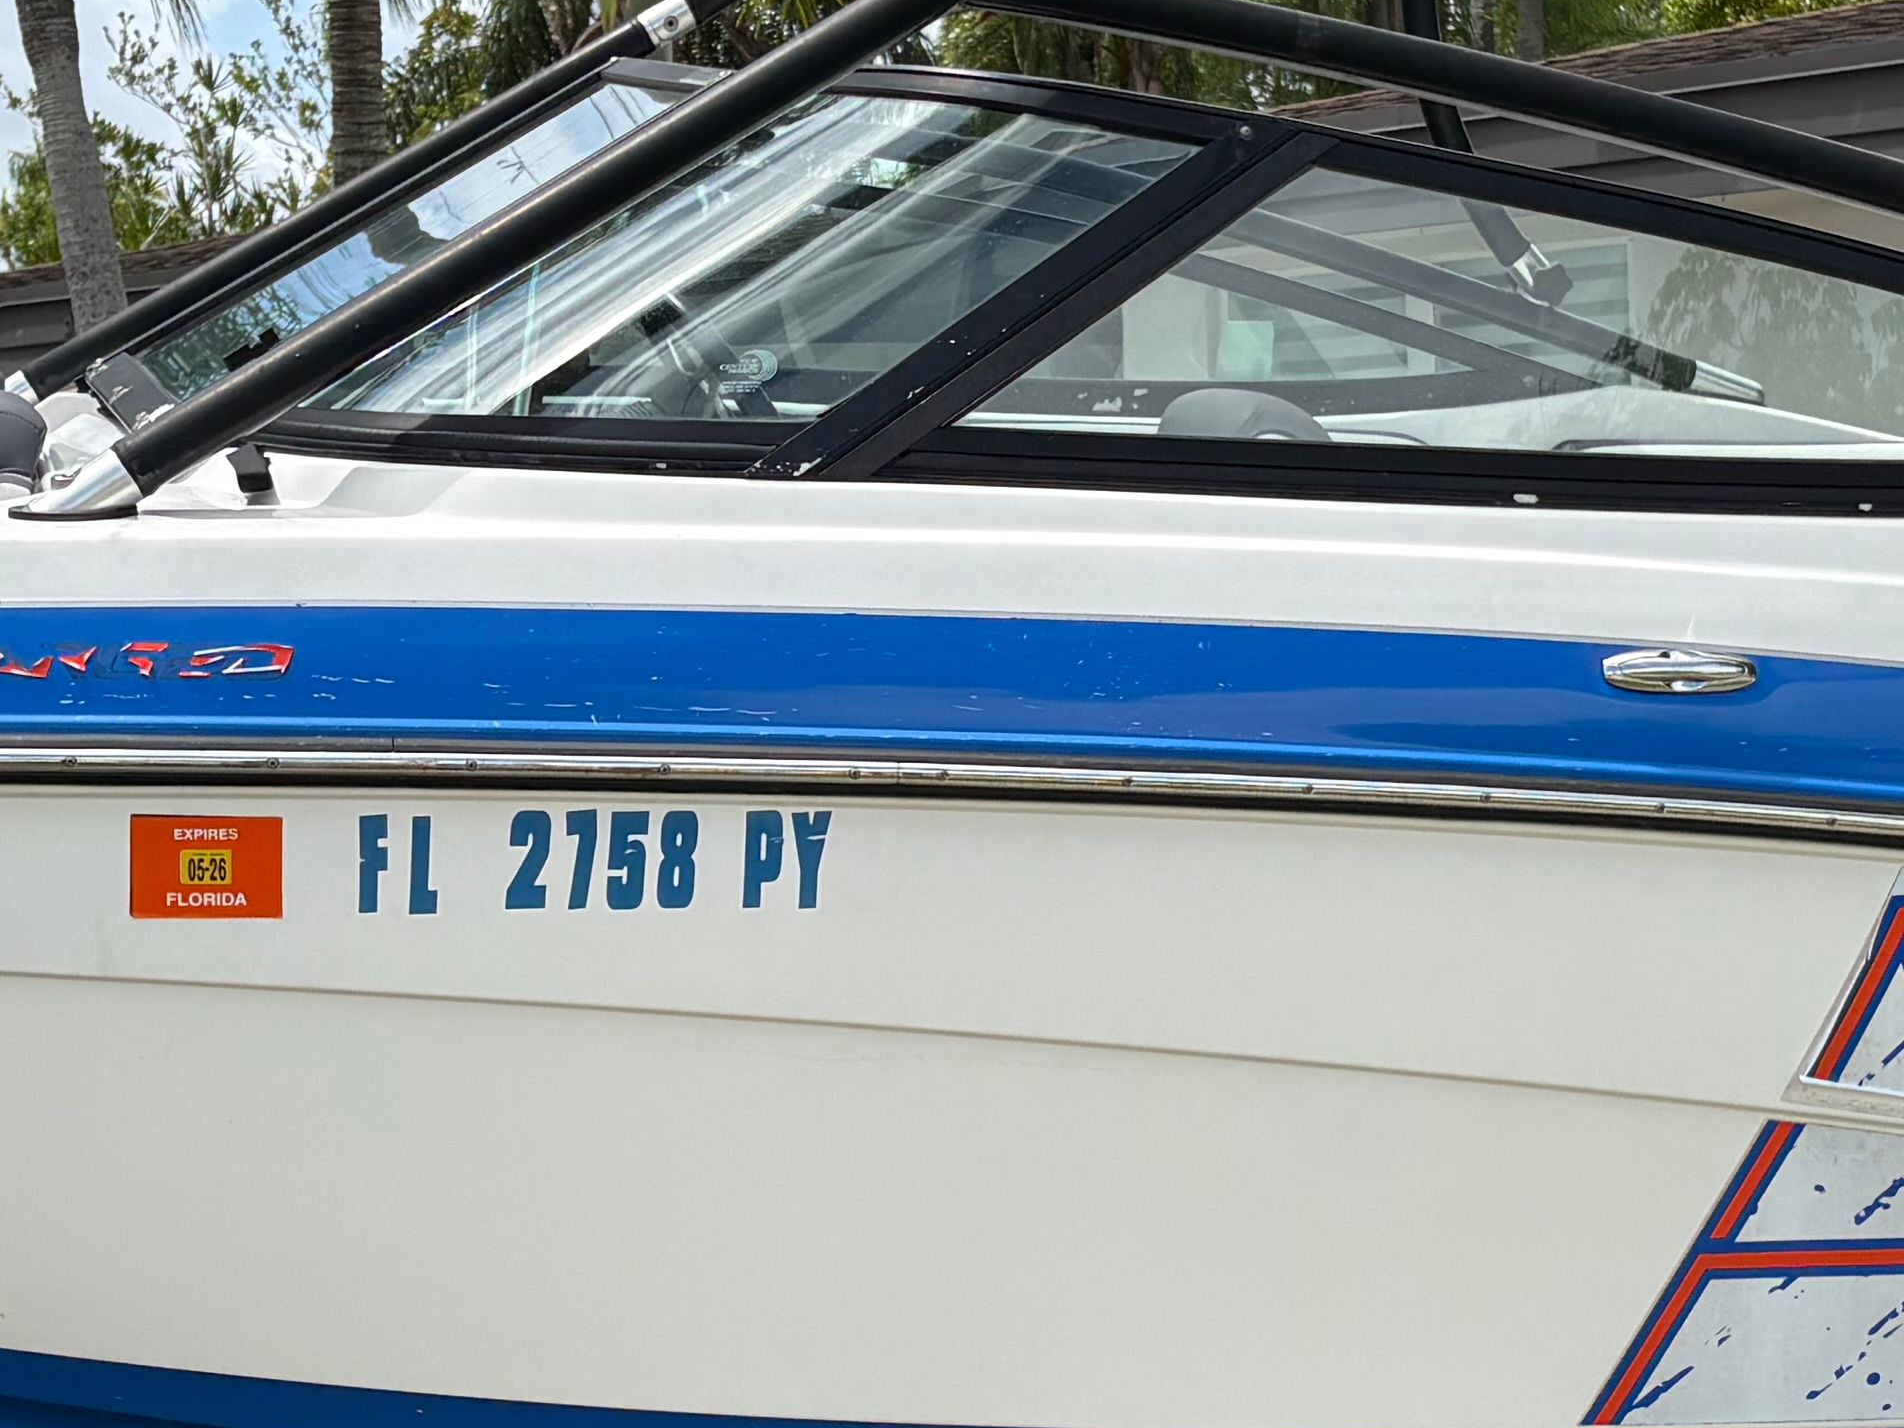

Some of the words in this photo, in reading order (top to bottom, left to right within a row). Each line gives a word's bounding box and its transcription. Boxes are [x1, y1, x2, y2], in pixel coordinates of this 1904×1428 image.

[173, 827, 239, 841] EXPIRES
[187, 857, 227, 882] 05-26
[358, 813, 438, 915] FL
[504, 808, 699, 910] 2758
[742, 809, 833, 909] PY
[165, 891, 248, 907] FLORIDA
